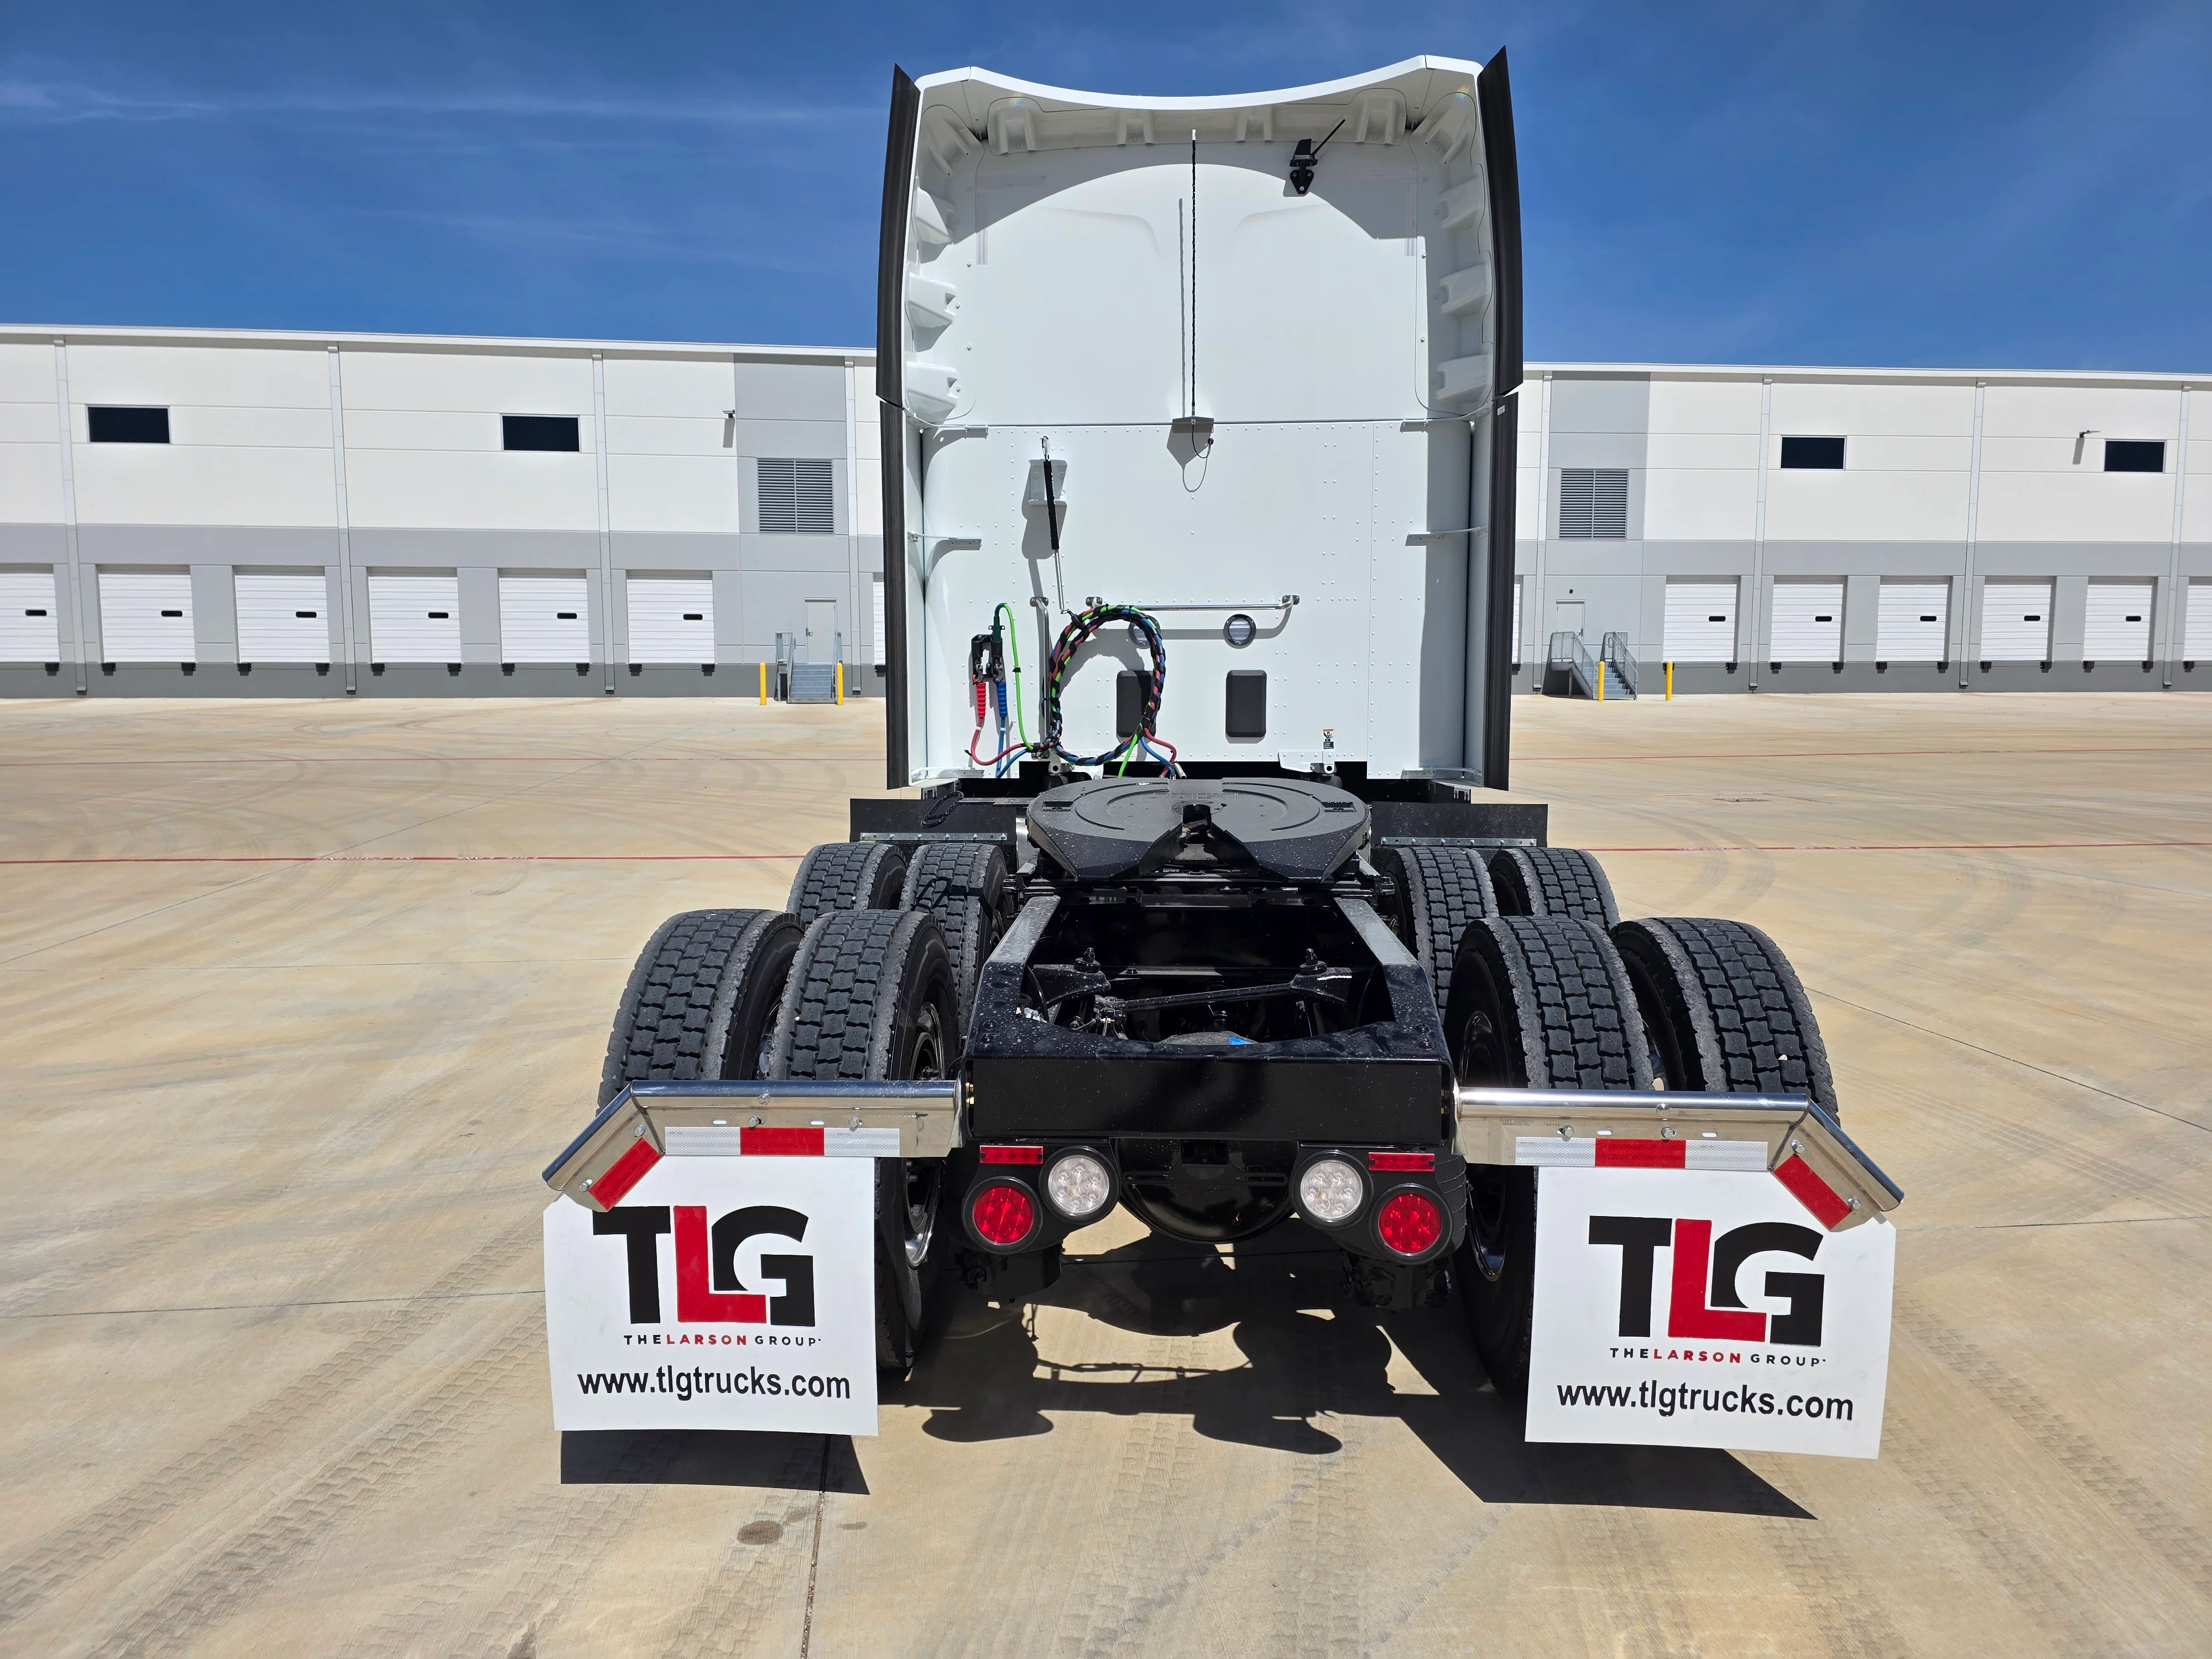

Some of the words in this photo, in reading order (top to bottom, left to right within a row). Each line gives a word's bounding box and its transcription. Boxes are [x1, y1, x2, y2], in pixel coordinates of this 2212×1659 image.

[593, 1206, 816, 1327] TLG
[1589, 1215, 1825, 1348] TLG
[755, 1335, 816, 1347] GROUP
[1751, 1354, 1820, 1367] GROUP
[577, 1365, 851, 1401] www.tlgtrucks.com
[1557, 1380, 1853, 1421] www.tlgtrucks.com
